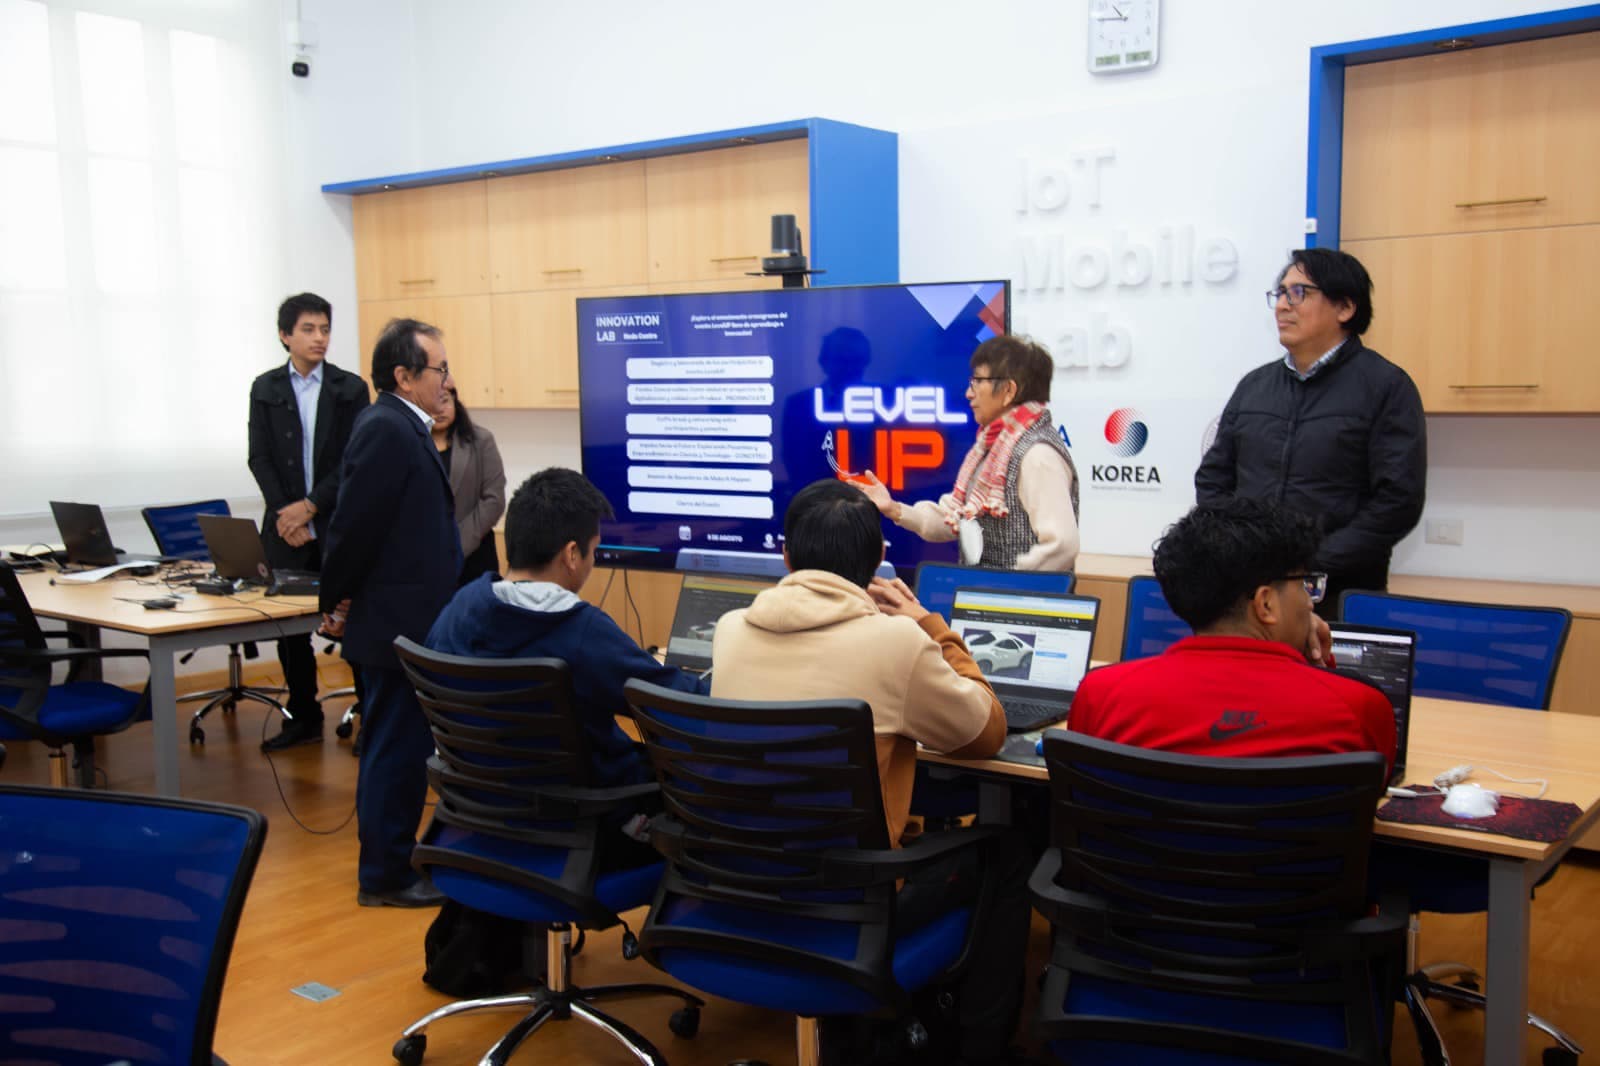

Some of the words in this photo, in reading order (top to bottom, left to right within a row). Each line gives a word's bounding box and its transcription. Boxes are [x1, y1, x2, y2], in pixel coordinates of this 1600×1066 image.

[1015, 148, 1117, 215] IoT
[1015, 225, 1240, 294] Mobile
[595, 314, 660, 327] INNOVATION
[596, 330, 616, 342] LAB
[813, 385, 968, 423] LEVEL
[835, 428, 945, 491] UP
[1091, 464, 1161, 484] KOREA
